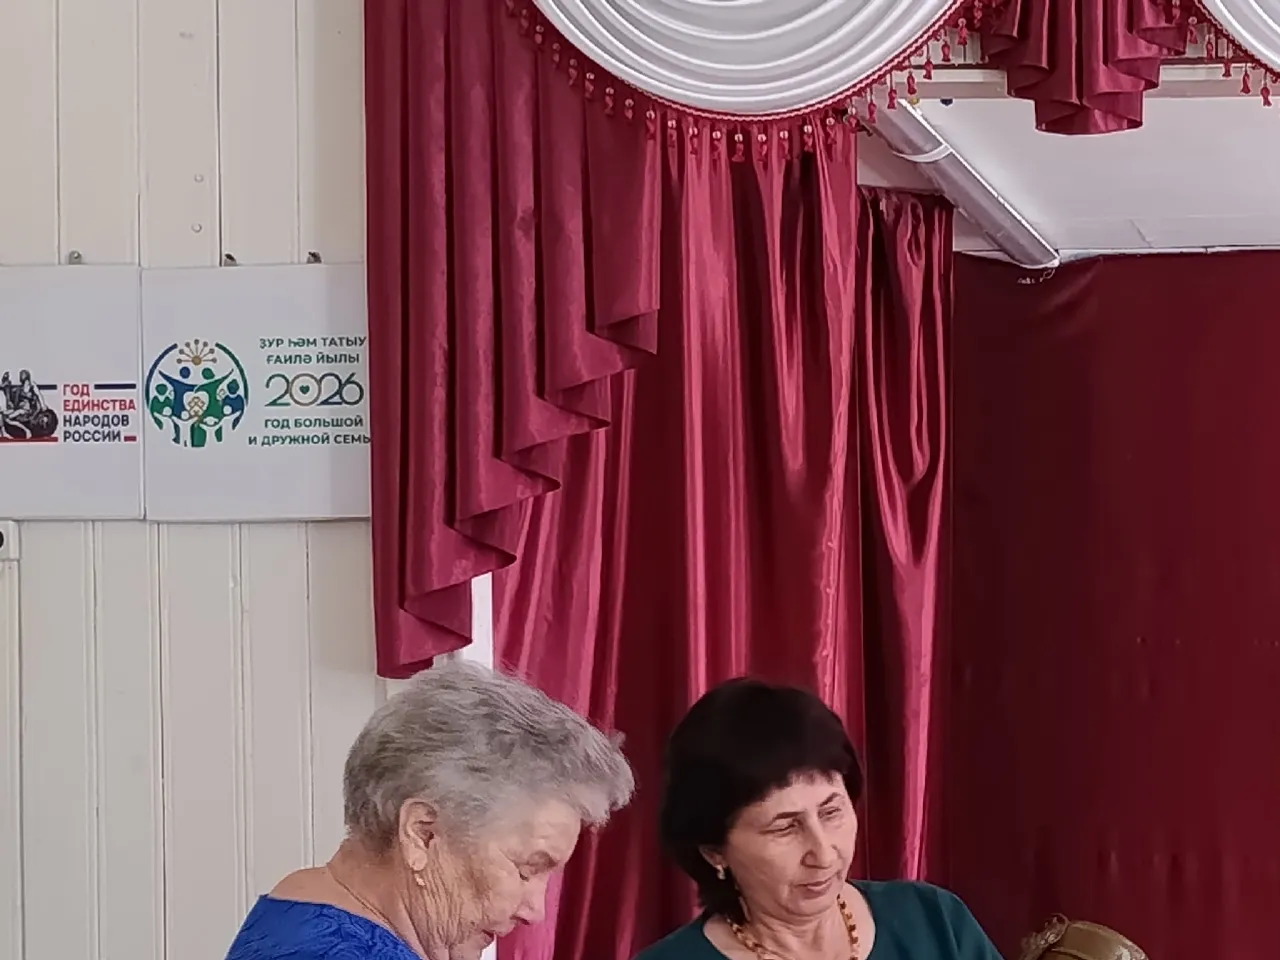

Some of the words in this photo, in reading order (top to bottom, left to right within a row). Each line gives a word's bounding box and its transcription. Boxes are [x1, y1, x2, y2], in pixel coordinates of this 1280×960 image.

[321, 336, 367, 347] ТАТЫУ
[316, 352, 359, 363] ЙЫЛЫ
[63, 384, 90, 397] ГОД
[264, 372, 364, 406] 2026
[63, 399, 136, 413] ЕДИНСТВА
[63, 414, 130, 428] НАРОДОВ
[264, 418, 290, 429] ГОД
[294, 415, 363, 428] БОЛЬШОЙ
[63, 430, 121, 442] РОССИИ
[248, 436, 257, 445] И
[261, 432, 330, 446] ДРУЖНОЙ
[334, 433, 371, 444] СЕМЬ
